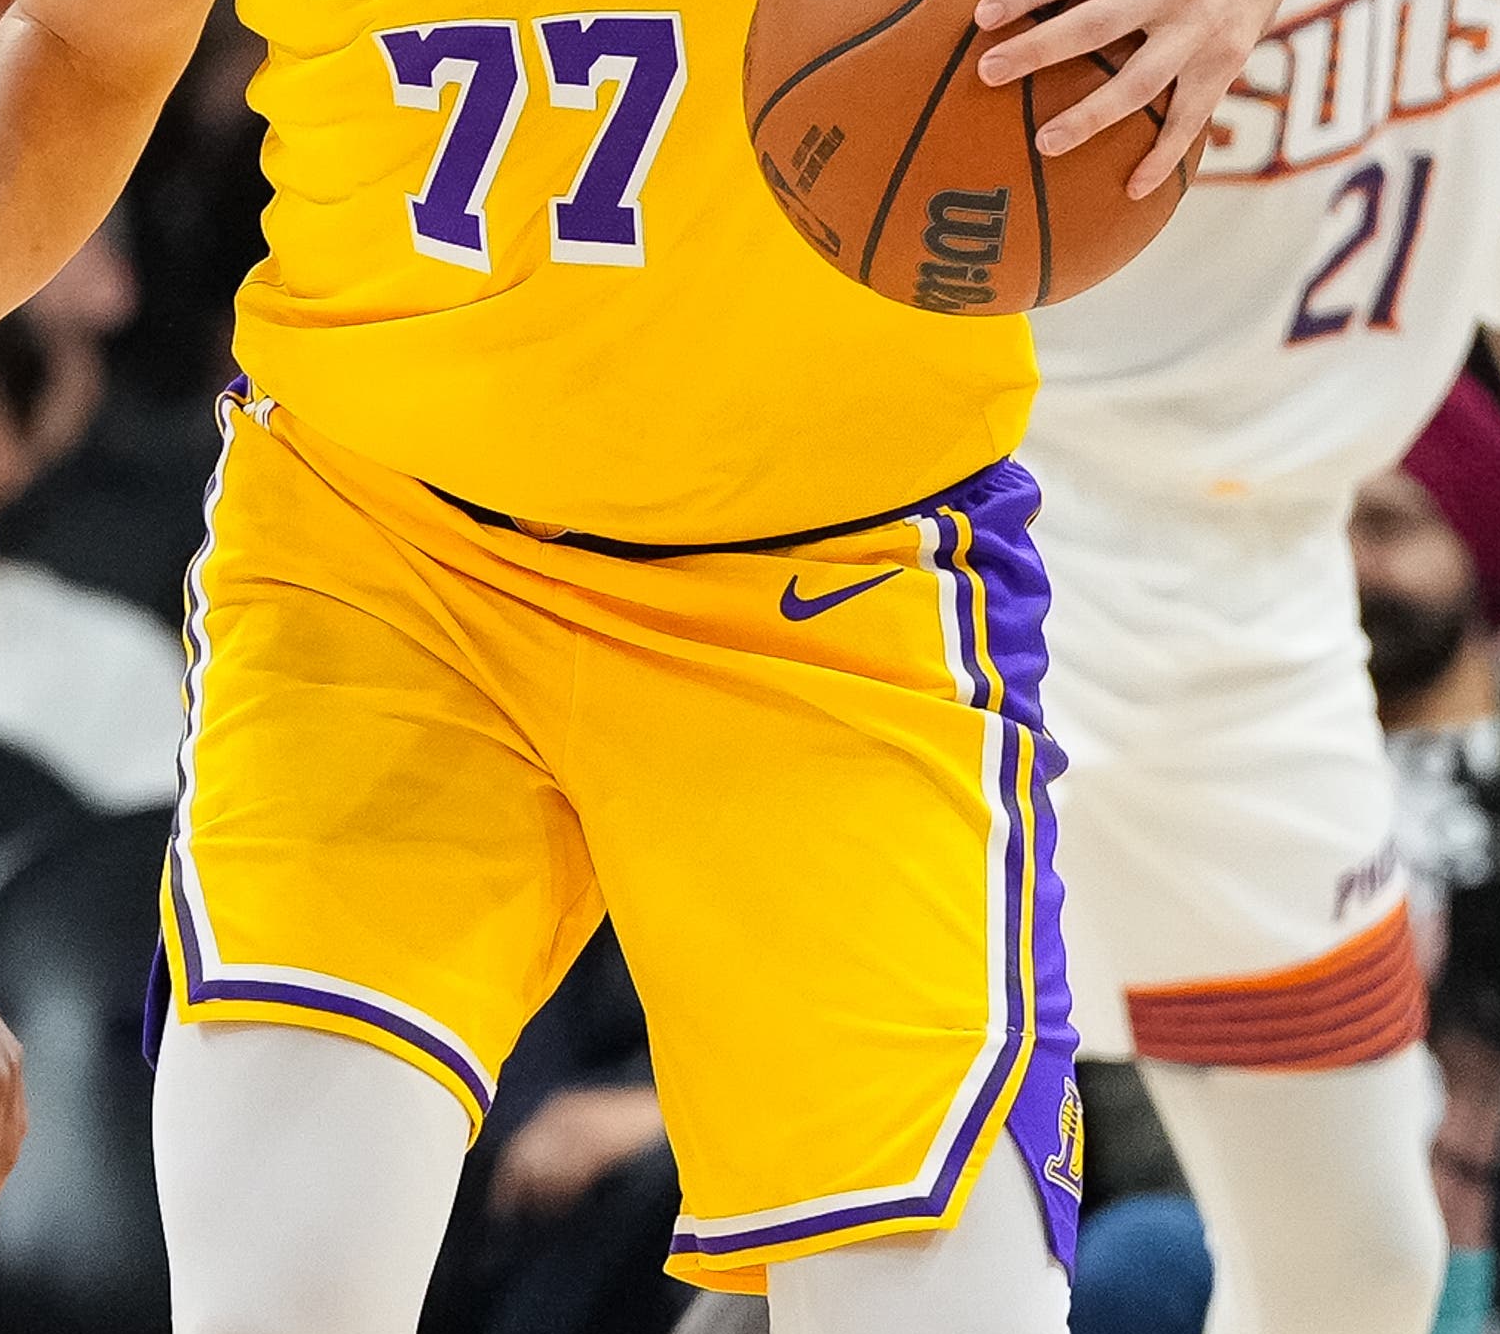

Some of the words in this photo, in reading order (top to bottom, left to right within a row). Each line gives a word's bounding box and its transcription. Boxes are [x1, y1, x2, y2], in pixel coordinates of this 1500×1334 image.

[371, 12, 688, 275] 77
[913, 186, 1010, 310] Wil
[1283, 150, 1435, 350] 21
